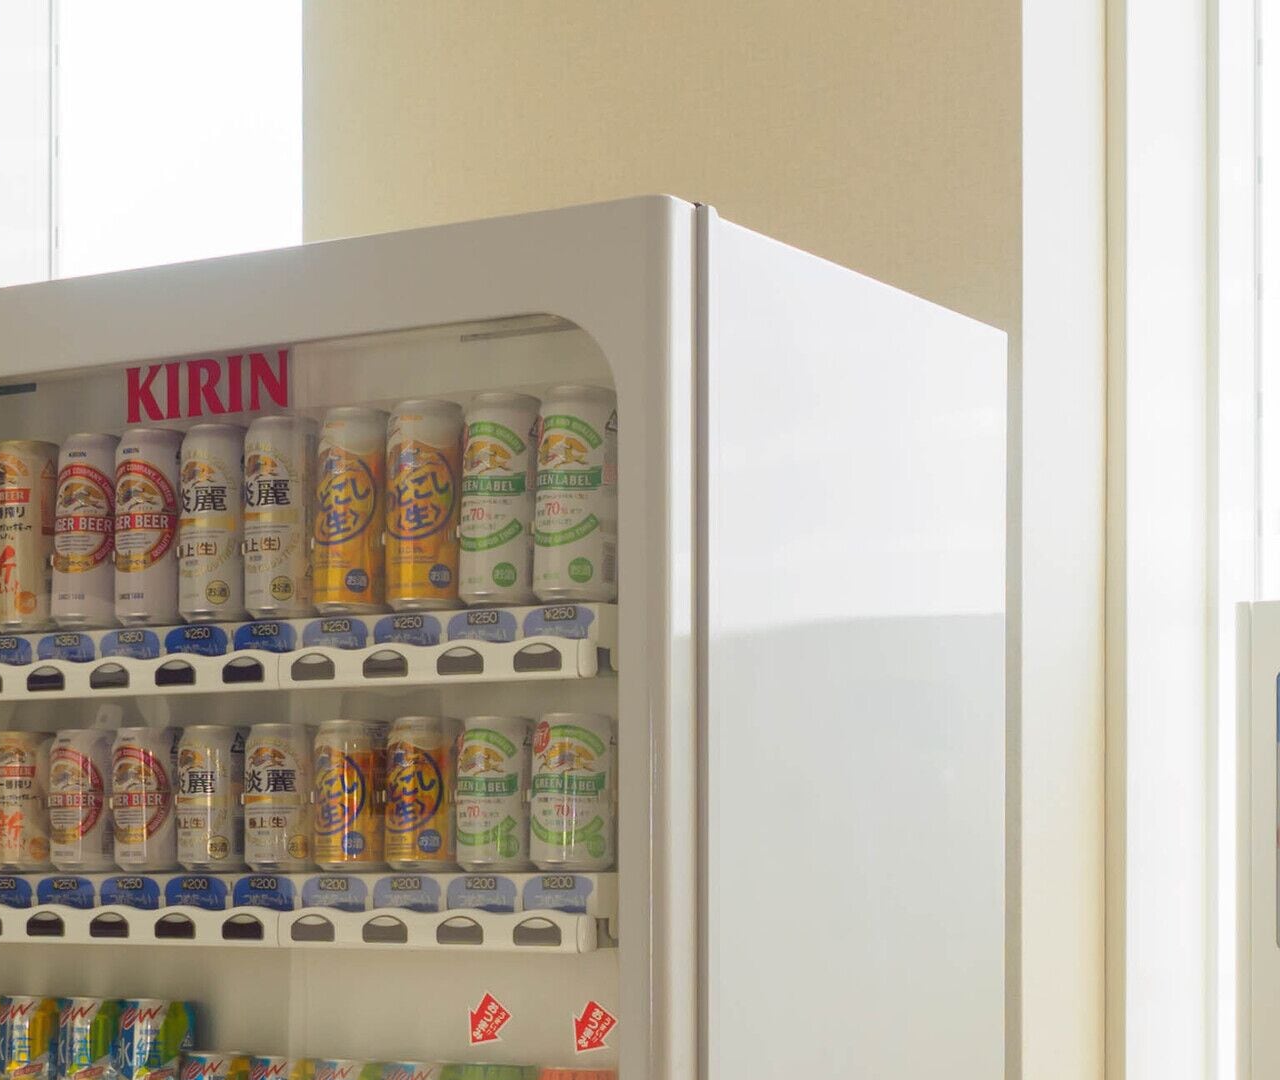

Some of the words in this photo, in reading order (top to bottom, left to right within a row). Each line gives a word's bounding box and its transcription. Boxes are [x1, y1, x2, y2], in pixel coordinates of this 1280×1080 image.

[126, 351, 290, 424] KIRIN
[556, 474, 592, 487] LABEL
[79, 517, 113, 531] BEER
[135, 514, 169, 529] BEER
[469, 612, 498, 624] ¥250
[544, 607, 575, 620] ¥250
[322, 620, 351, 632] ¥250
[393, 616, 422, 628] ¥250
[185, 627, 210, 639] ¥250
[251, 623, 279, 636] ¥250
[180, 770, 216, 794] 麗
[66, 794, 96, 807] BEER
[132, 793, 163, 806] BEER
[465, 877, 495, 889] ¥200
[543, 876, 574, 888] ¥200
